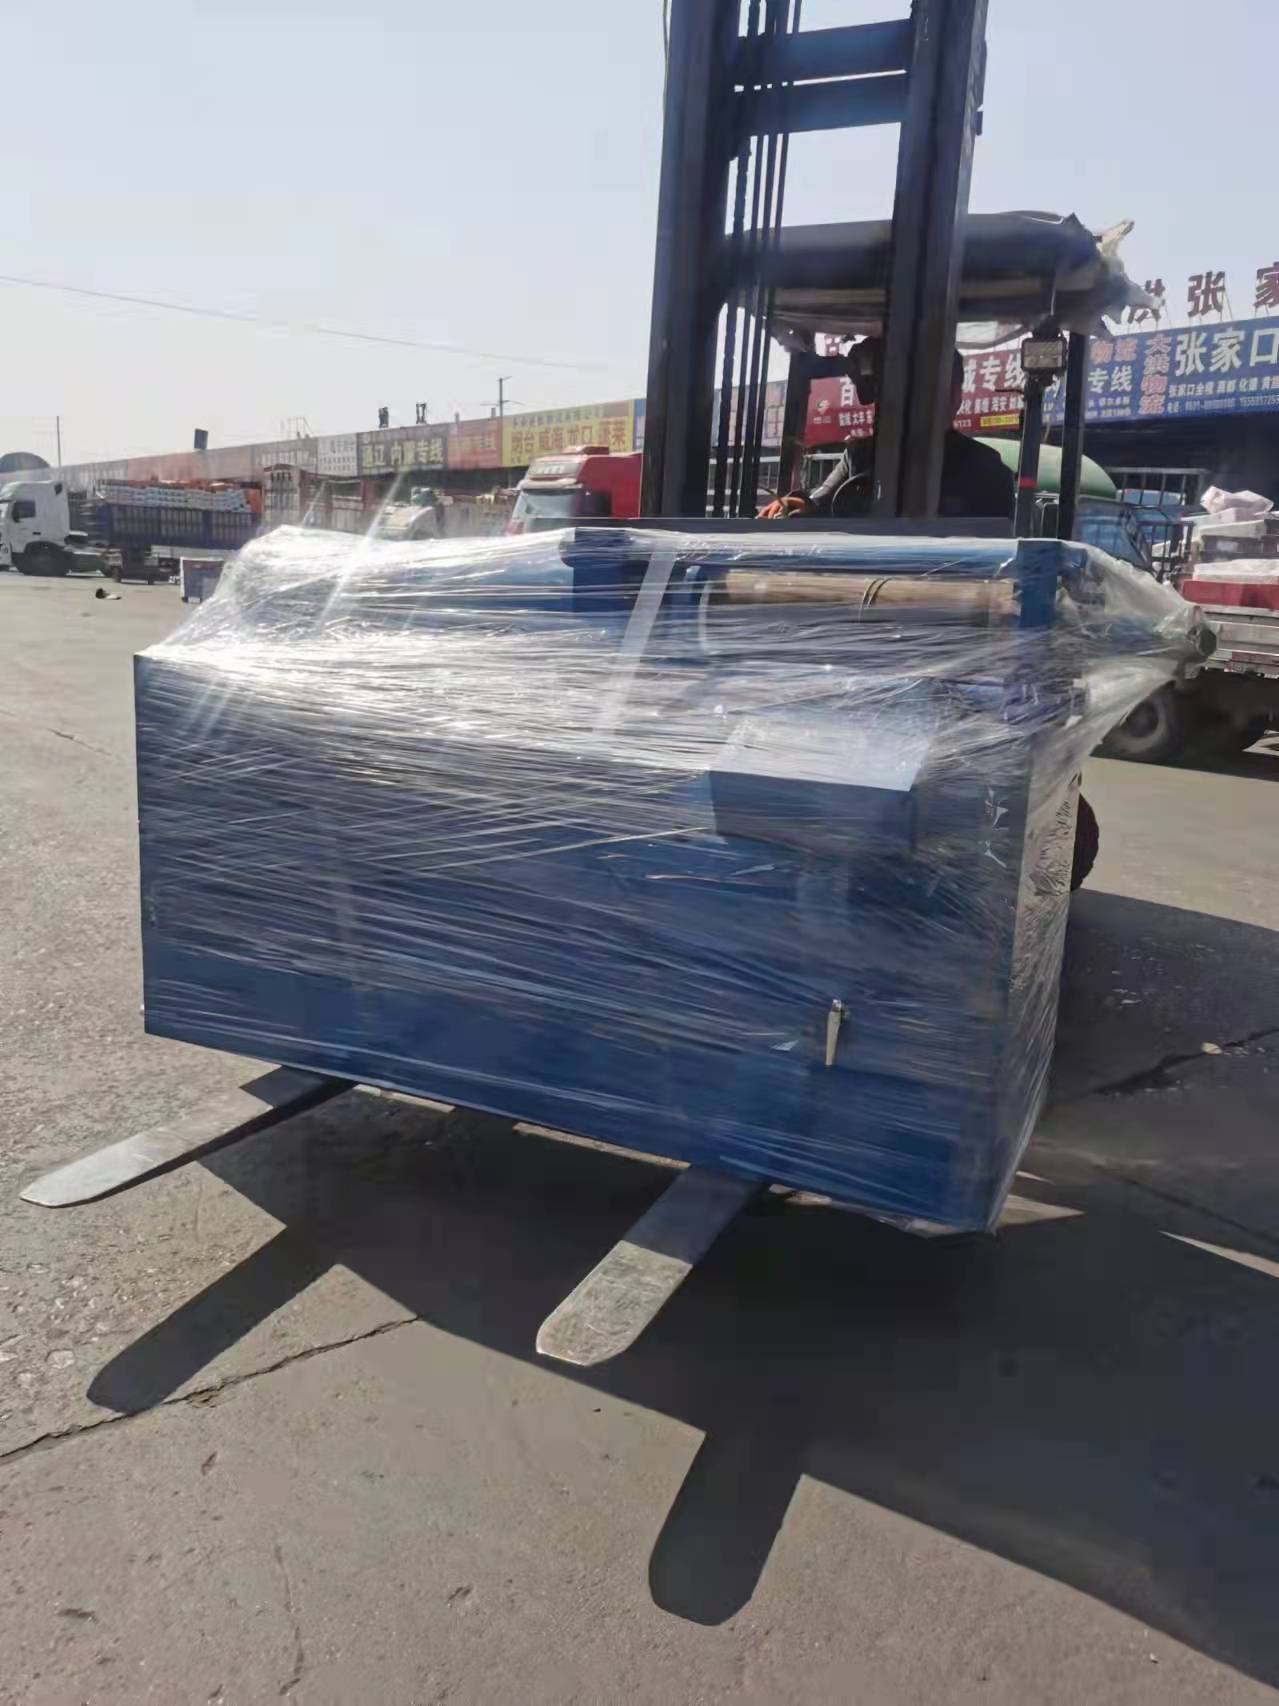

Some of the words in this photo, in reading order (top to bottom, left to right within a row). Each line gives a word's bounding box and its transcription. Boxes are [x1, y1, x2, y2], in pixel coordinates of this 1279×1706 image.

[1175, 328, 1279, 377] 张家口
[1088, 365, 1131, 393] 专线
